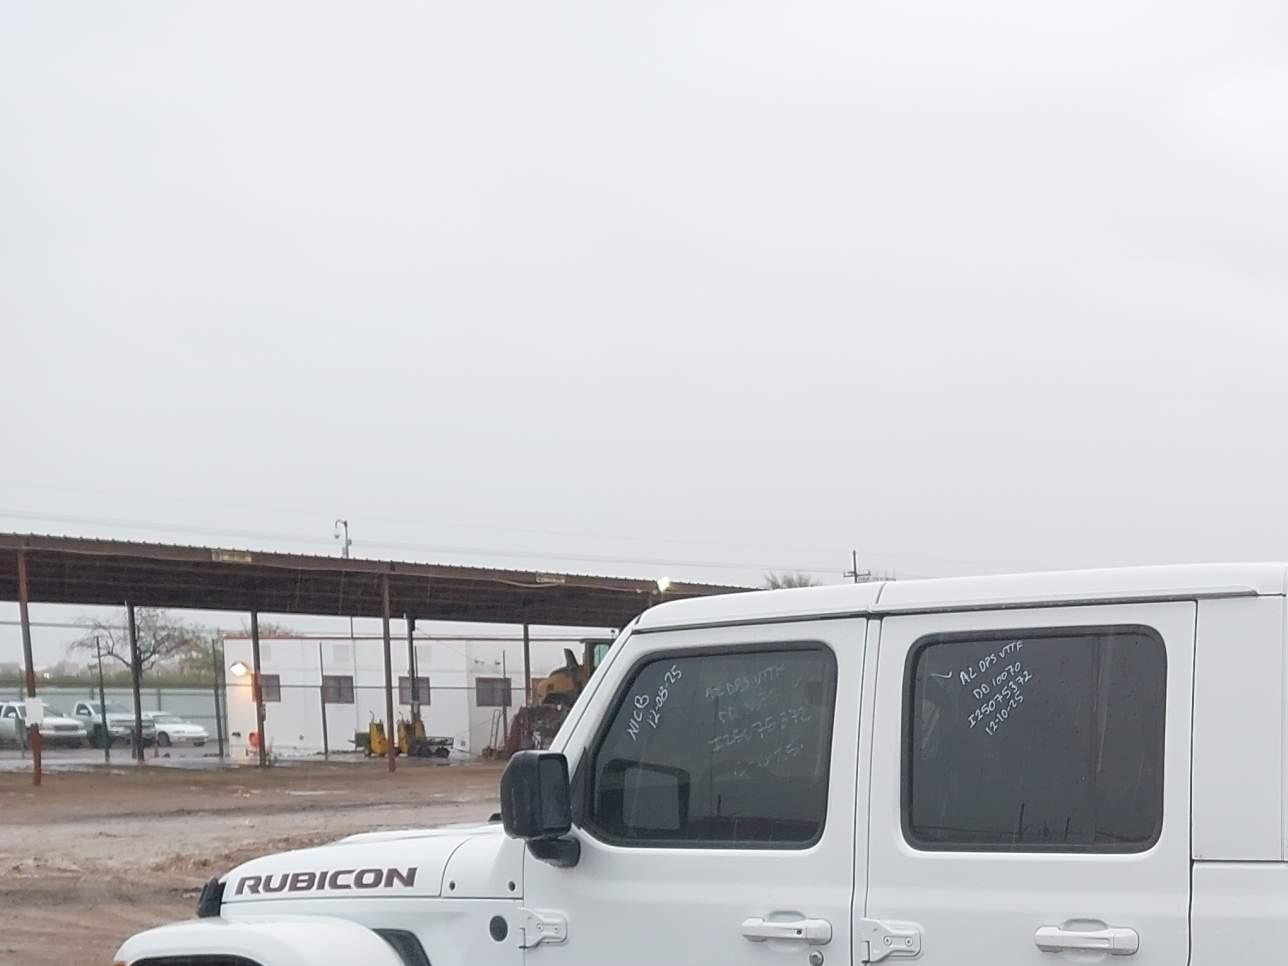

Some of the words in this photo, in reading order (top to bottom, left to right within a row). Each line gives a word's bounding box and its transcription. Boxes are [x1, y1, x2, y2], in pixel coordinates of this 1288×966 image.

[992, 661, 1021, 687] 10070
[985, 691, 1024, 736] 12-10-25
[234, 867, 418, 896] RUBICON
